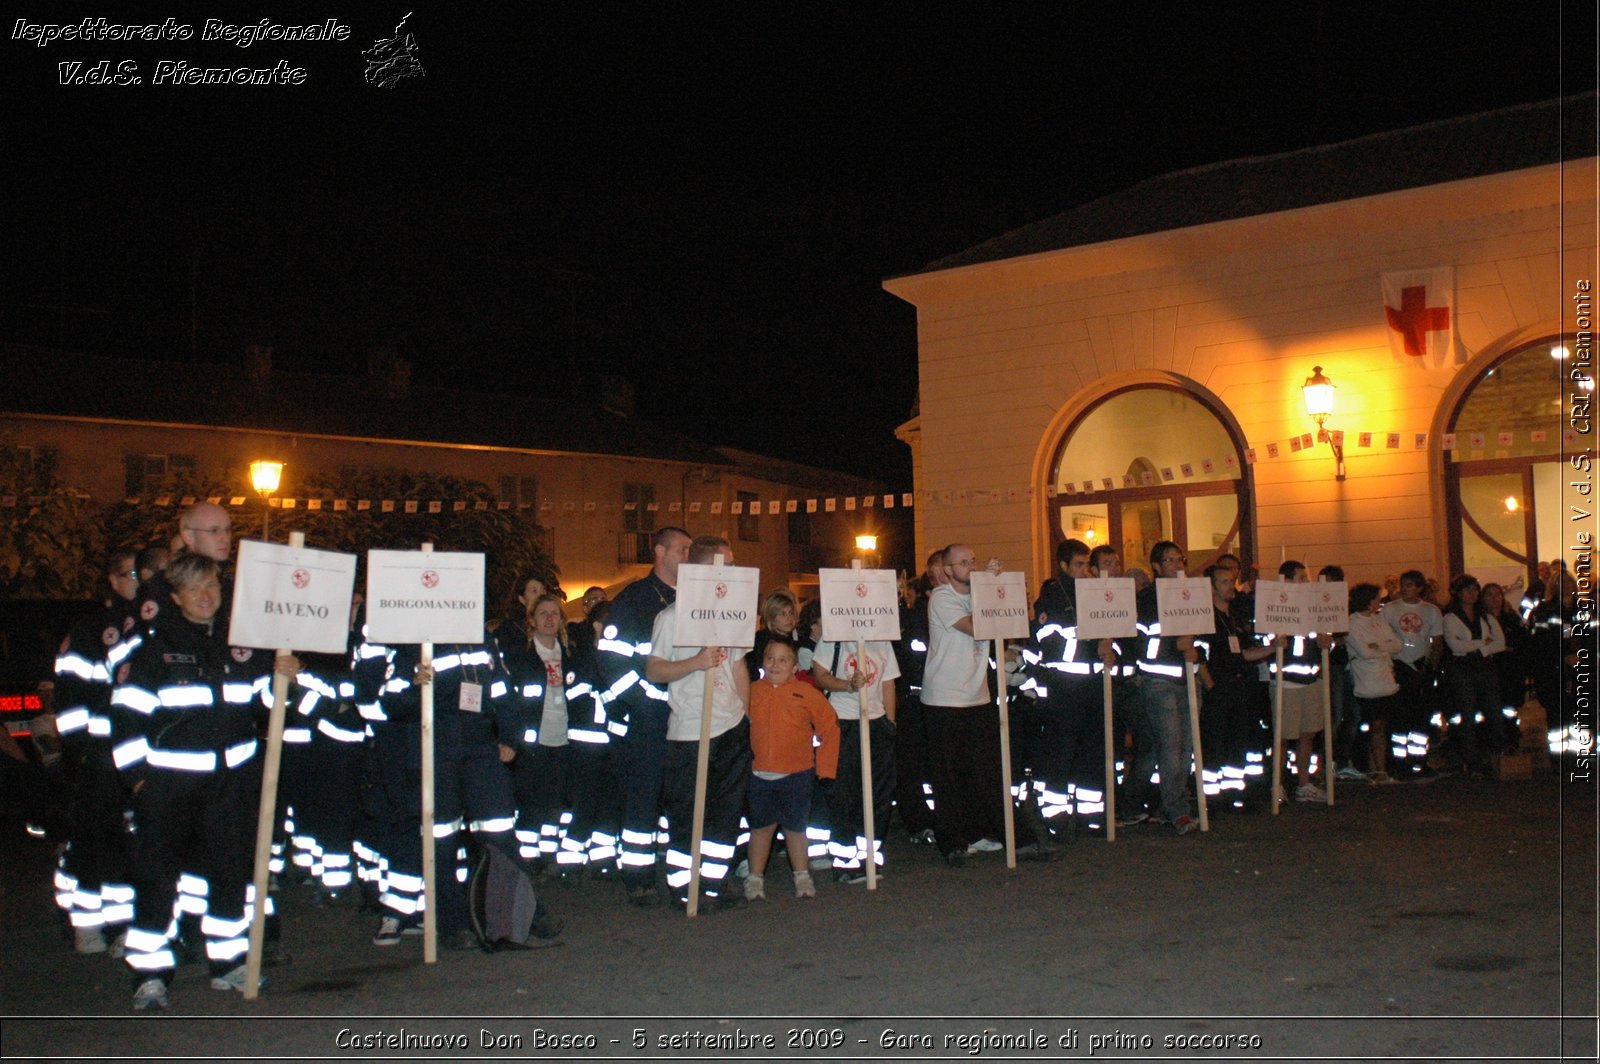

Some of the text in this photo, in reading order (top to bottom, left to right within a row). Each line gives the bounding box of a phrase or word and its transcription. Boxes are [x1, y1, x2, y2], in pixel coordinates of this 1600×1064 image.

[264, 600, 329, 619] BAVENO
[379, 599, 476, 610] BORGOMANERO
[1266, 605, 1300, 614] SETTIMO
[1307, 605, 1345, 614] VILLANOVA
[690, 608, 747, 621] CHIVASSO
[830, 606, 894, 616] GRAVELLONA
[980, 608, 1025, 618] MONCALVO
[1089, 610, 1129, 620] OLEGGIO
[1162, 607, 1212, 618] SAVIGLIANO
[851, 618, 876, 628] TOCE
[1317, 615, 1338, 624] D'ASTI
